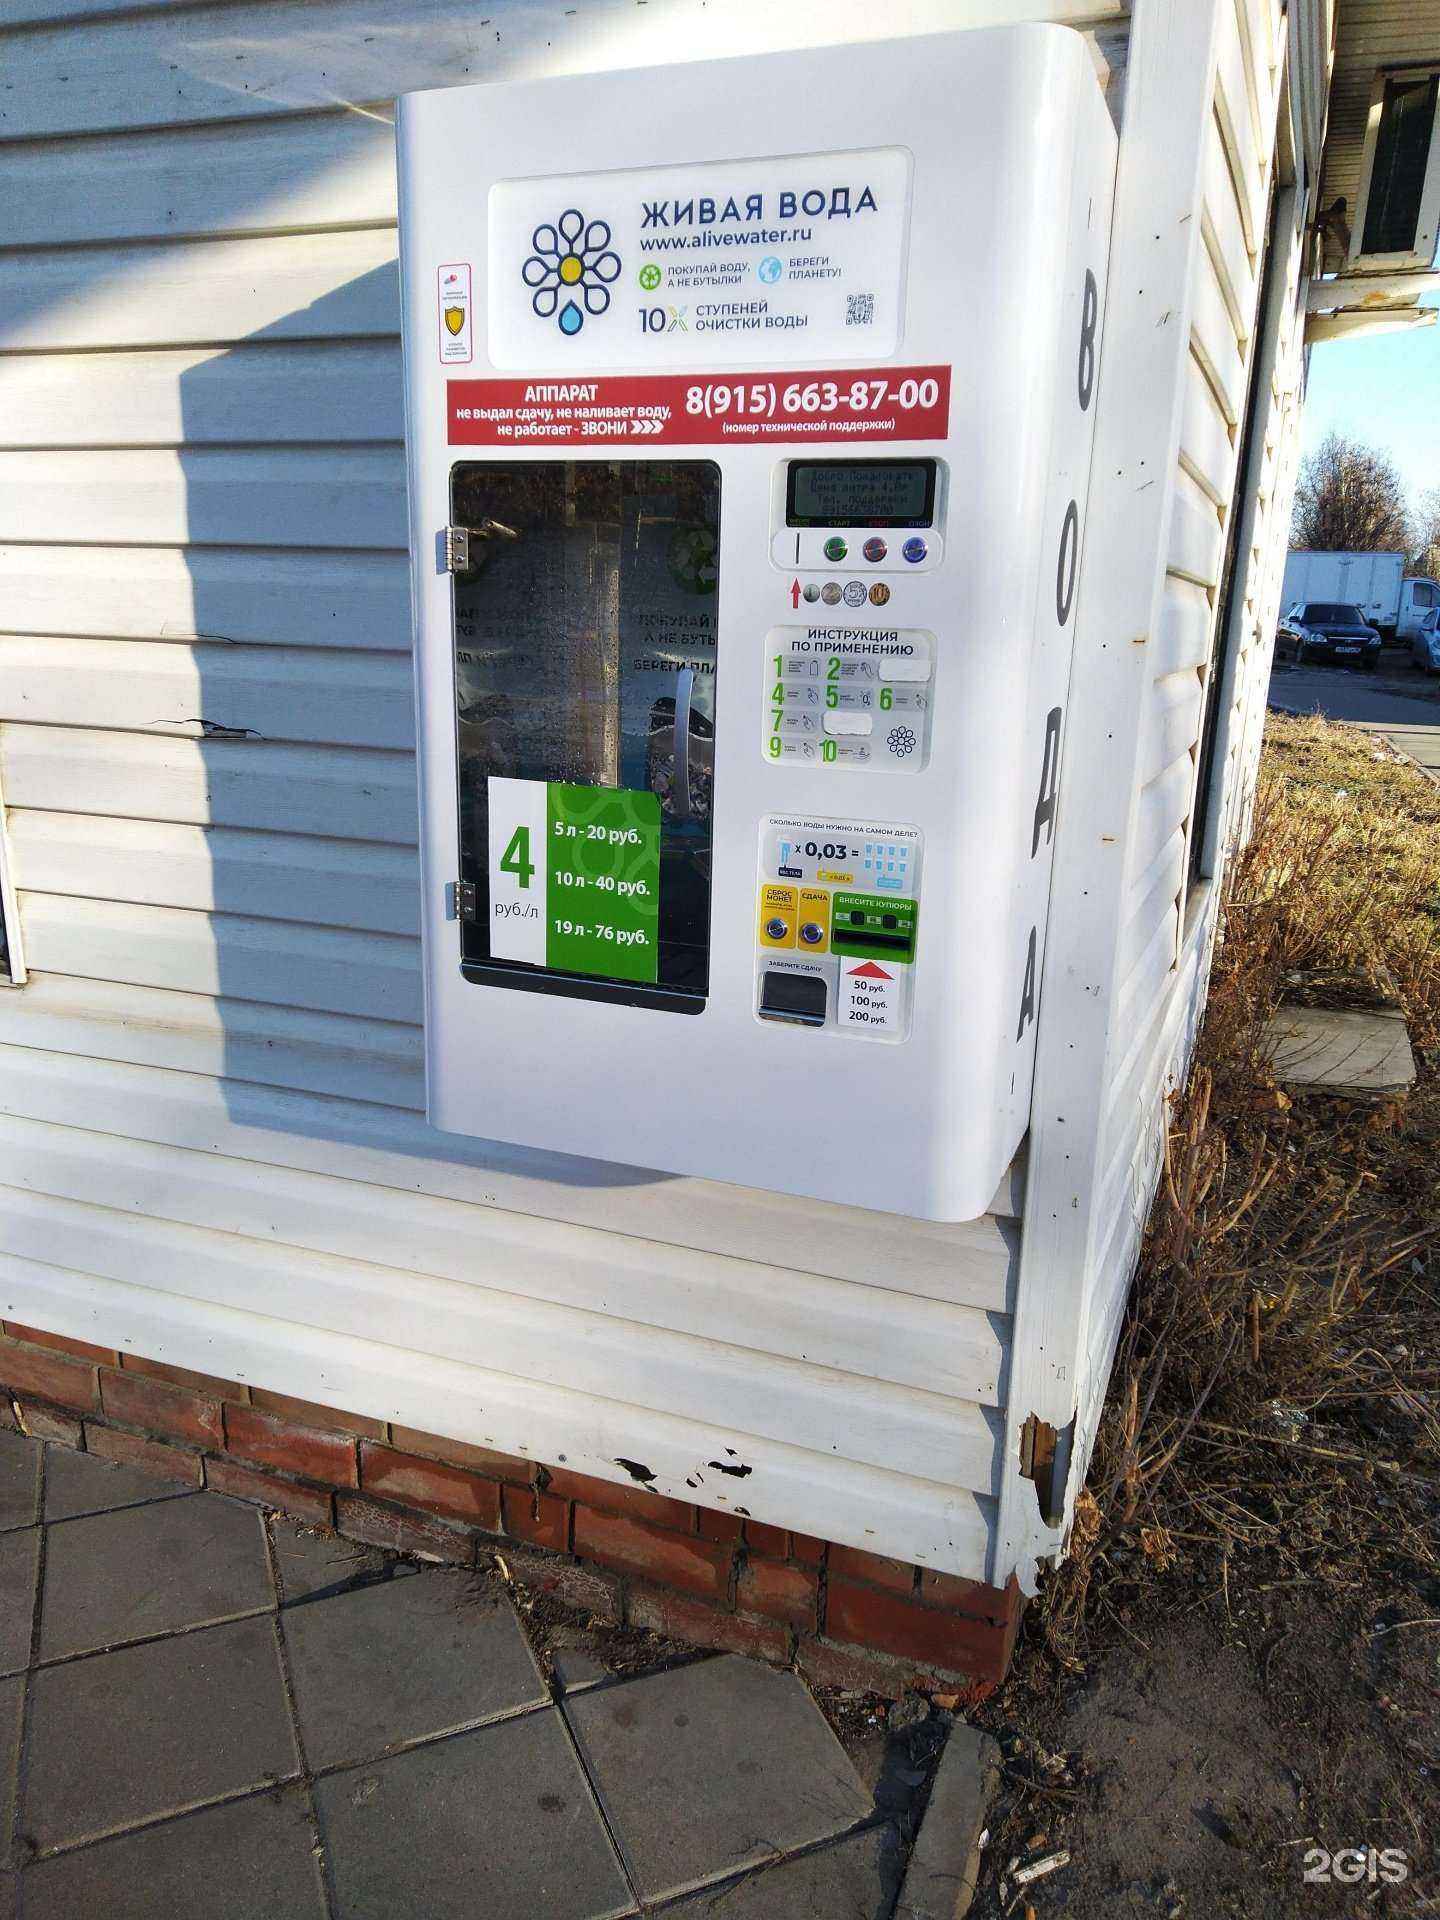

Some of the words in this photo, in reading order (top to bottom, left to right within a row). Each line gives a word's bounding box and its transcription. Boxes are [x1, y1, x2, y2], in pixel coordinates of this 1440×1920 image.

[641, 193, 763, 228] ЖИВАЯ
[779, 185, 878, 221] ВОДА
[640, 226, 812, 251] www.alivewater.ru
[668, 262, 717, 275] ПОКУПАЙ
[720, 262, 751, 273] ВОДУ,
[789, 256, 829, 267] БЕРЕГИ
[668, 279, 675, 288] А
[677, 278, 691, 287] НЕ
[693, 275, 742, 287] БУТЫЛКИ
[788, 268, 842, 280] ПЛАНЕТУ!
[696, 300, 768, 316] СТУПЕНЕЙ
[696, 316, 762, 331] ОЧИСТКИ
[765, 315, 808, 329] ВОДЫ
[525, 384, 598, 402] АППАРАТ
[685, 383, 776, 418] 8(915)
[782, 378, 939, 412] 663-87-00
[456, 408, 472, 419] не
[473, 407, 513, 421] выдал
[515, 407, 554, 421] сдачу,
[556, 407, 572, 418] не
[574, 406, 635, 418] наливает
[637, 406, 672, 420] воду,
[497, 424, 512, 435] не
[514, 422, 572, 438] работает
[581, 421, 627, 435] ЗВОНИ
[722, 423, 759, 434] (номер
[761, 420, 827, 432] технической
[829, 418, 895, 431] поддержки)
[808, 629, 898, 642] ИНСТРУКЦИЯ
[791, 641, 811, 651] ПО
[814, 642, 914, 656] ПРИМЕНЕНИЮ
[773, 655, 783, 678] 1
[827, 657, 841, 680] 2
[771, 683, 785, 705] 4
[826, 685, 839, 708] 5
[880, 688, 893, 710] 6
[771, 709, 784, 732] 7
[769, 737, 782, 758] 9
[819, 739, 837, 762] 10
[555, 822, 564, 836] 5
[587, 825, 606, 840] 20
[609, 828, 642, 846] руб.
[769, 819, 801, 827] СКОЛЬКО
[803, 821, 825, 829] ВОДЫ
[826, 824, 852, 832] НУЖНО
[866, 827, 893, 836] САМОМ
[894, 830, 918, 838] ДЕЛЕ?
[500, 826, 535, 889] 4
[804, 841, 847, 860] 0,03
[555, 871, 573, 886] 10
[595, 876, 614, 891] 40
[617, 878, 650, 896] руб.
[768, 889, 792, 897] СБРОС
[802, 893, 827, 901] СДАЧА
[495, 902, 538, 919] руб./л
[839, 896, 875, 907] ВНЕСИТЕ
[875, 901, 912, 911] КУПЮРЫ
[555, 920, 572, 934] 19
[595, 925, 614, 940] 76
[616, 927, 650, 945] руб.
[768, 961, 800, 969] ЗАБЕРИТЕ
[854, 980, 867, 990] 50
[868, 985, 886, 993] руб.
[850, 995, 870, 1006] 100
[871, 1000, 888, 1009] руб.
[849, 1010, 869, 1022] 200
[870, 1016, 887, 1024] руб.
